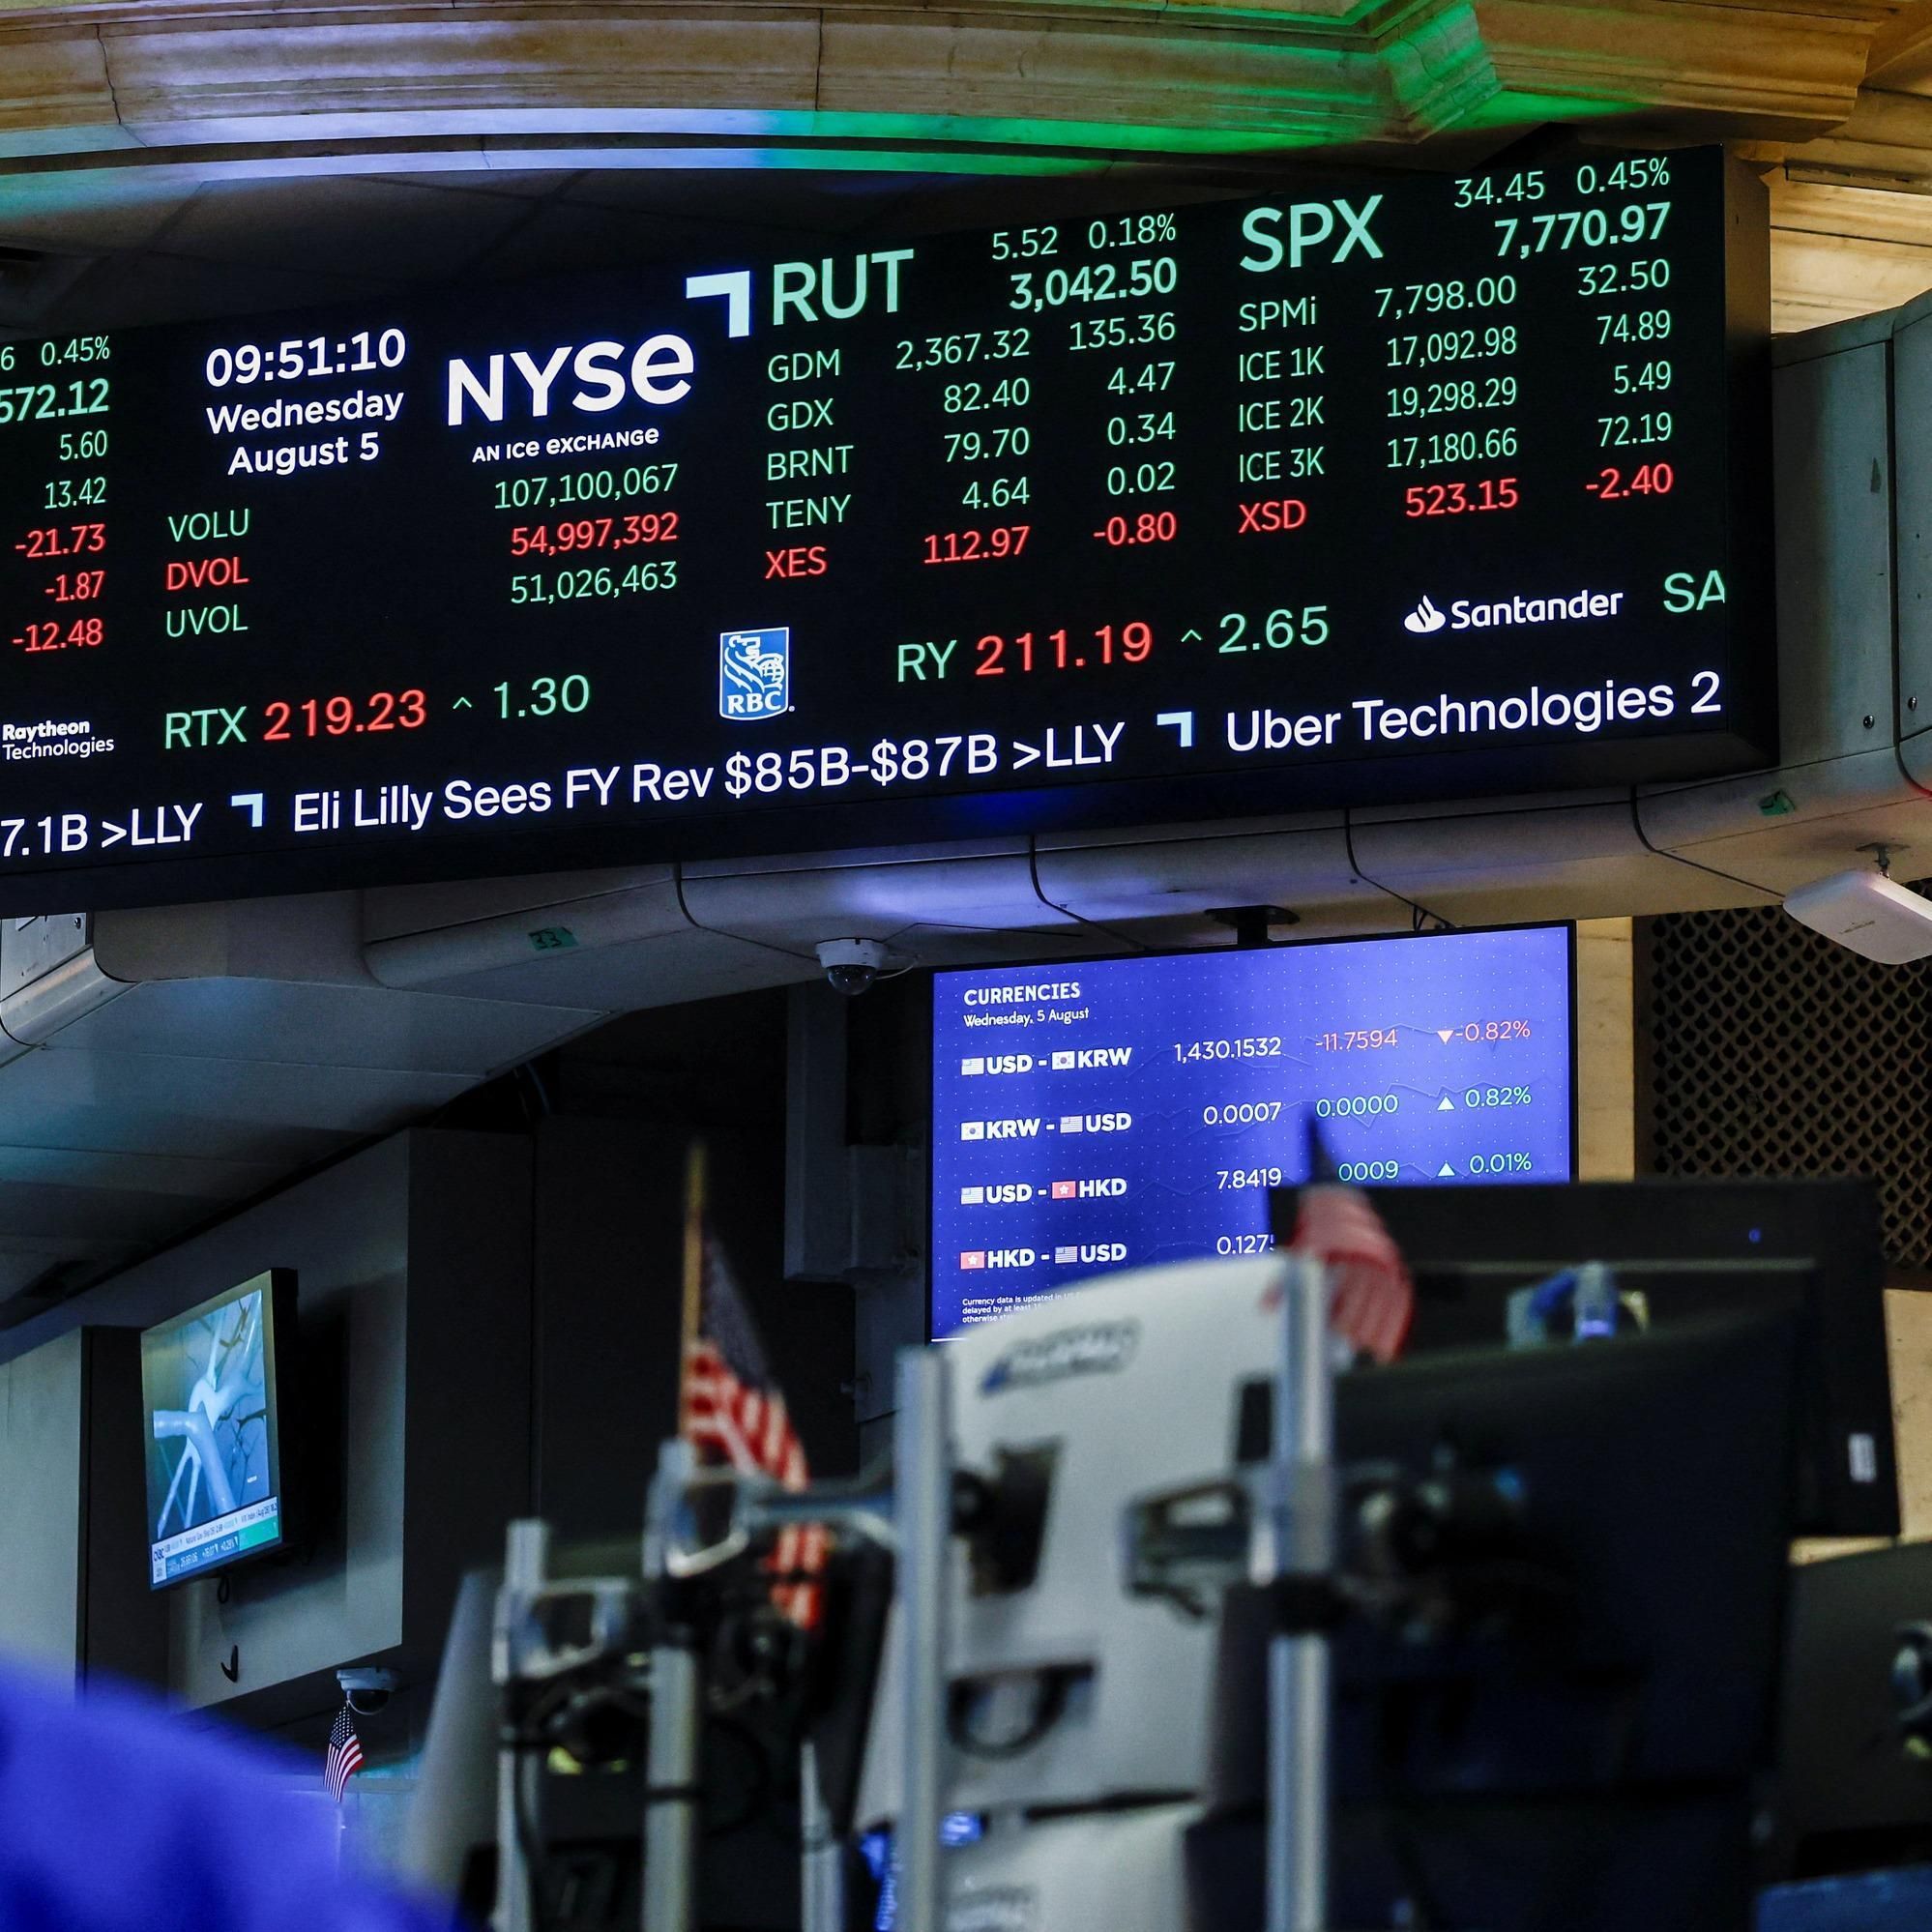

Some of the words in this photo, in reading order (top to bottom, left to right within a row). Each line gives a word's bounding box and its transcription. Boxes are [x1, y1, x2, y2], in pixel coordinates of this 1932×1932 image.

[1454, 171, 1544, 208] 34.45
[1577, 157, 1669, 193] 0.45%
[992, 226, 1057, 260] 5.52
[1089, 213, 1176, 249] 0.18%
[1241, 194, 1383, 272] SPX
[1495, 202, 1670, 259] 7,770.97
[774, 249, 914, 325] RUT
[1010, 257, 1176, 312] 3,042.50
[1240, 296, 1315, 332] SPMi
[1375, 276, 1515, 319] 7,798.00
[1578, 259, 1669, 295] 32.50
[1, 346, 15, 370] 6
[42, 336, 109, 366] 0.45%
[206, 329, 405, 387] 09:51:10
[769, 349, 839, 382] GDM
[896, 328, 1029, 371] 2,367.32
[1069, 312, 1175, 350] 135.36
[1240, 351, 1280, 382] ICE
[1291, 346, 1324, 376] 1K
[1388, 326, 1516, 367] 17,092.98
[1597, 309, 1670, 344] 74.89
[0, 378, 108, 423] 572.12
[206, 390, 404, 434] Wednesday
[768, 398, 833, 431] GDX
[945, 378, 1029, 413] 82.40
[1108, 362, 1175, 395] 4.47
[1240, 401, 1280, 432] ICE
[1290, 396, 1324, 426] 2K
[1388, 377, 1516, 418] 19,298.29
[1615, 361, 1671, 394] 5.49
[60, 430, 107, 460] 5.60
[228, 437, 348, 475] August
[360, 432, 378, 460] 5
[472, 445, 500, 462] AN
[768, 445, 854, 481] BRNT
[945, 427, 1029, 462] 79.70
[1108, 412, 1176, 445] 0.34
[1241, 452, 1280, 483] ICE
[1290, 447, 1324, 477] 3K
[1388, 427, 1516, 468] 17,180.66
[1598, 412, 1671, 447] 72.19
[45, 477, 105, 509] 13.42
[168, 509, 249, 542] VOLU
[495, 463, 678, 509] 107,100,067
[766, 494, 851, 529] TENY
[962, 477, 1030, 509] 4.64
[1108, 462, 1175, 495] 0.02
[1239, 500, 1306, 533] XSD
[1406, 478, 1518, 516] 523.15
[1586, 463, 1673, 498] -2.40
[15, 524, 105, 557] -21.73
[166, 557, 249, 590] DVOL
[512, 512, 678, 556] 54,997,392
[766, 546, 827, 578] XES
[924, 526, 1030, 563] 112.97
[1094, 512, 1176, 545] -0.80
[45, 571, 104, 601] -1.87
[167, 604, 248, 637] UVOL
[512, 561, 676, 603] 51,026,463
[1451, 590, 1623, 629] Santander
[13, 619, 102, 652] -12.48
[898, 640, 956, 682] RY
[976, 623, 1152, 675] 211.19
[1219, 606, 1328, 653] 2.65
[166, 706, 247, 748] RTX
[264, 689, 425, 740] 219.23
[494, 675, 589, 718] 1.30
[727, 690, 781, 714] RBC
[1228, 709, 1341, 751] Uber
[1352, 680, 1674, 740] Technologies
[1691, 671, 1721, 713] 2
[2, 720, 90, 743] Raytheon
[2, 737, 114, 760] Technologies
[295, 791, 339, 832] Eli
[355, 785, 433, 830] Lilly
[444, 780, 551, 819] Sees
[567, 766, 620, 808] FY
[633, 764, 714, 803] Rev
[725, 734, 997, 799] $85B-$87B
[1013, 722, 1125, 770] >LLY
[1, 814, 88, 857] 7.1B
[102, 803, 203, 848] >LLY
[964, 982, 1080, 1005] CURRENCIES
[964, 1011, 1034, 1028] Wednesday,
[1037, 1010, 1045, 1022] 5
[1048, 1007, 1089, 1024] August
[986, 1054, 1032, 1074] USD
[1078, 1047, 1132, 1068] KRW
[1174, 1037, 1281, 1065] 1,430.1532
[1315, 1028, 1398, 1052] -11.7594
[1455, 1020, 1531, 1042] -0.82%
[987, 1119, 1040, 1139] KRW
[1086, 1113, 1132, 1132] USD
[1203, 1102, 1282, 1126] 0.0007
[1316, 1094, 1398, 1118] 0.0000
[1465, 1086, 1532, 1108] 0.82%
[986, 1184, 1032, 1204] USD
[1079, 1178, 1127, 1198] HKD
[1216, 1167, 1282, 1190] 7.8419
[1338, 1160, 1399, 1182] 0009
[1469, 1153, 1532, 1174] 0.01%
[987, 1248, 1036, 1268] HKD
[1080, 1244, 1127, 1263] USD
[962, 1298, 995, 1306] Currency
[1023, 1294, 1053, 1303] updated
[962, 1305, 991, 1314] delayed
[993, 1305, 1003, 1314] by
